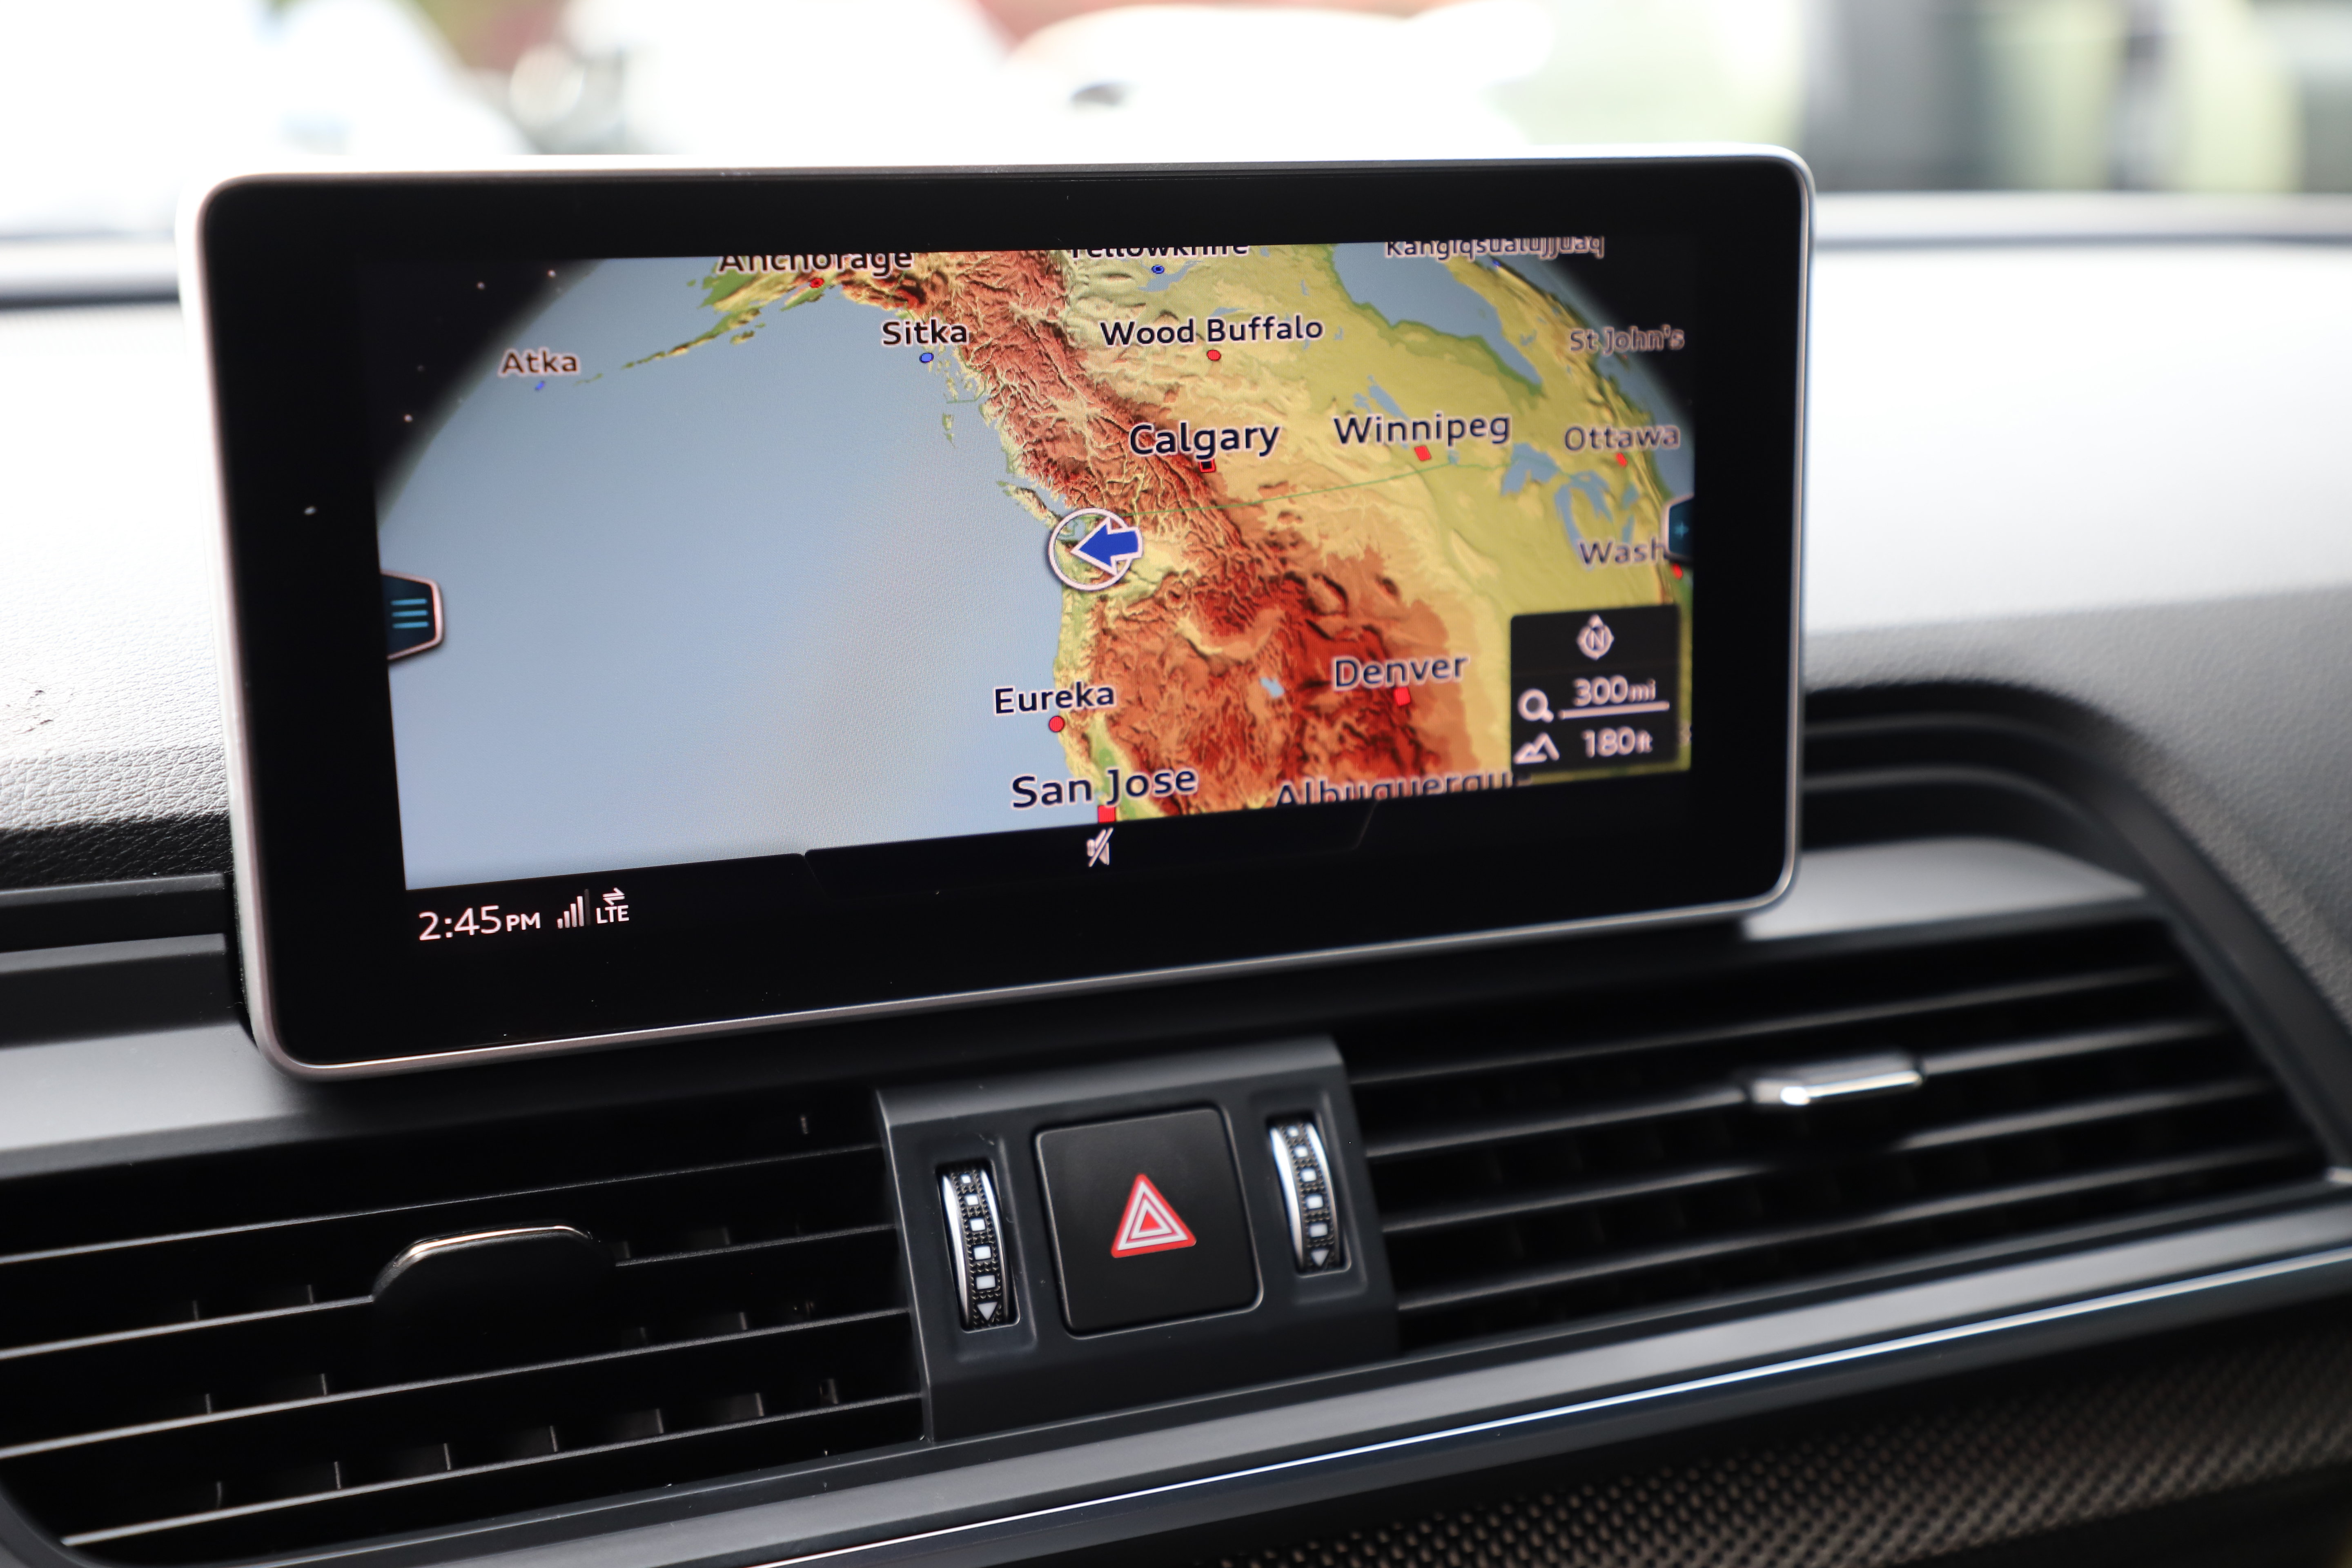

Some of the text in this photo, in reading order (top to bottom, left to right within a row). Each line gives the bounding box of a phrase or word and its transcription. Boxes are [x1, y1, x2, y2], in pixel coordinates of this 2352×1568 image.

[883, 321, 967, 345] Sitka
[1101, 316, 1323, 345] Wood Buffalo
[1570, 330, 1598, 351] St
[501, 350, 577, 374] Atka
[1130, 422, 1280, 459] Calgary
[1334, 412, 1511, 446] Winnipeg
[1565, 426, 1679, 450] Ottawa
[1335, 657, 1468, 688] Denver
[995, 682, 1114, 714] Eureka
[1012, 769, 1196, 808] San Jose
[596, 905, 629, 924] LTE
